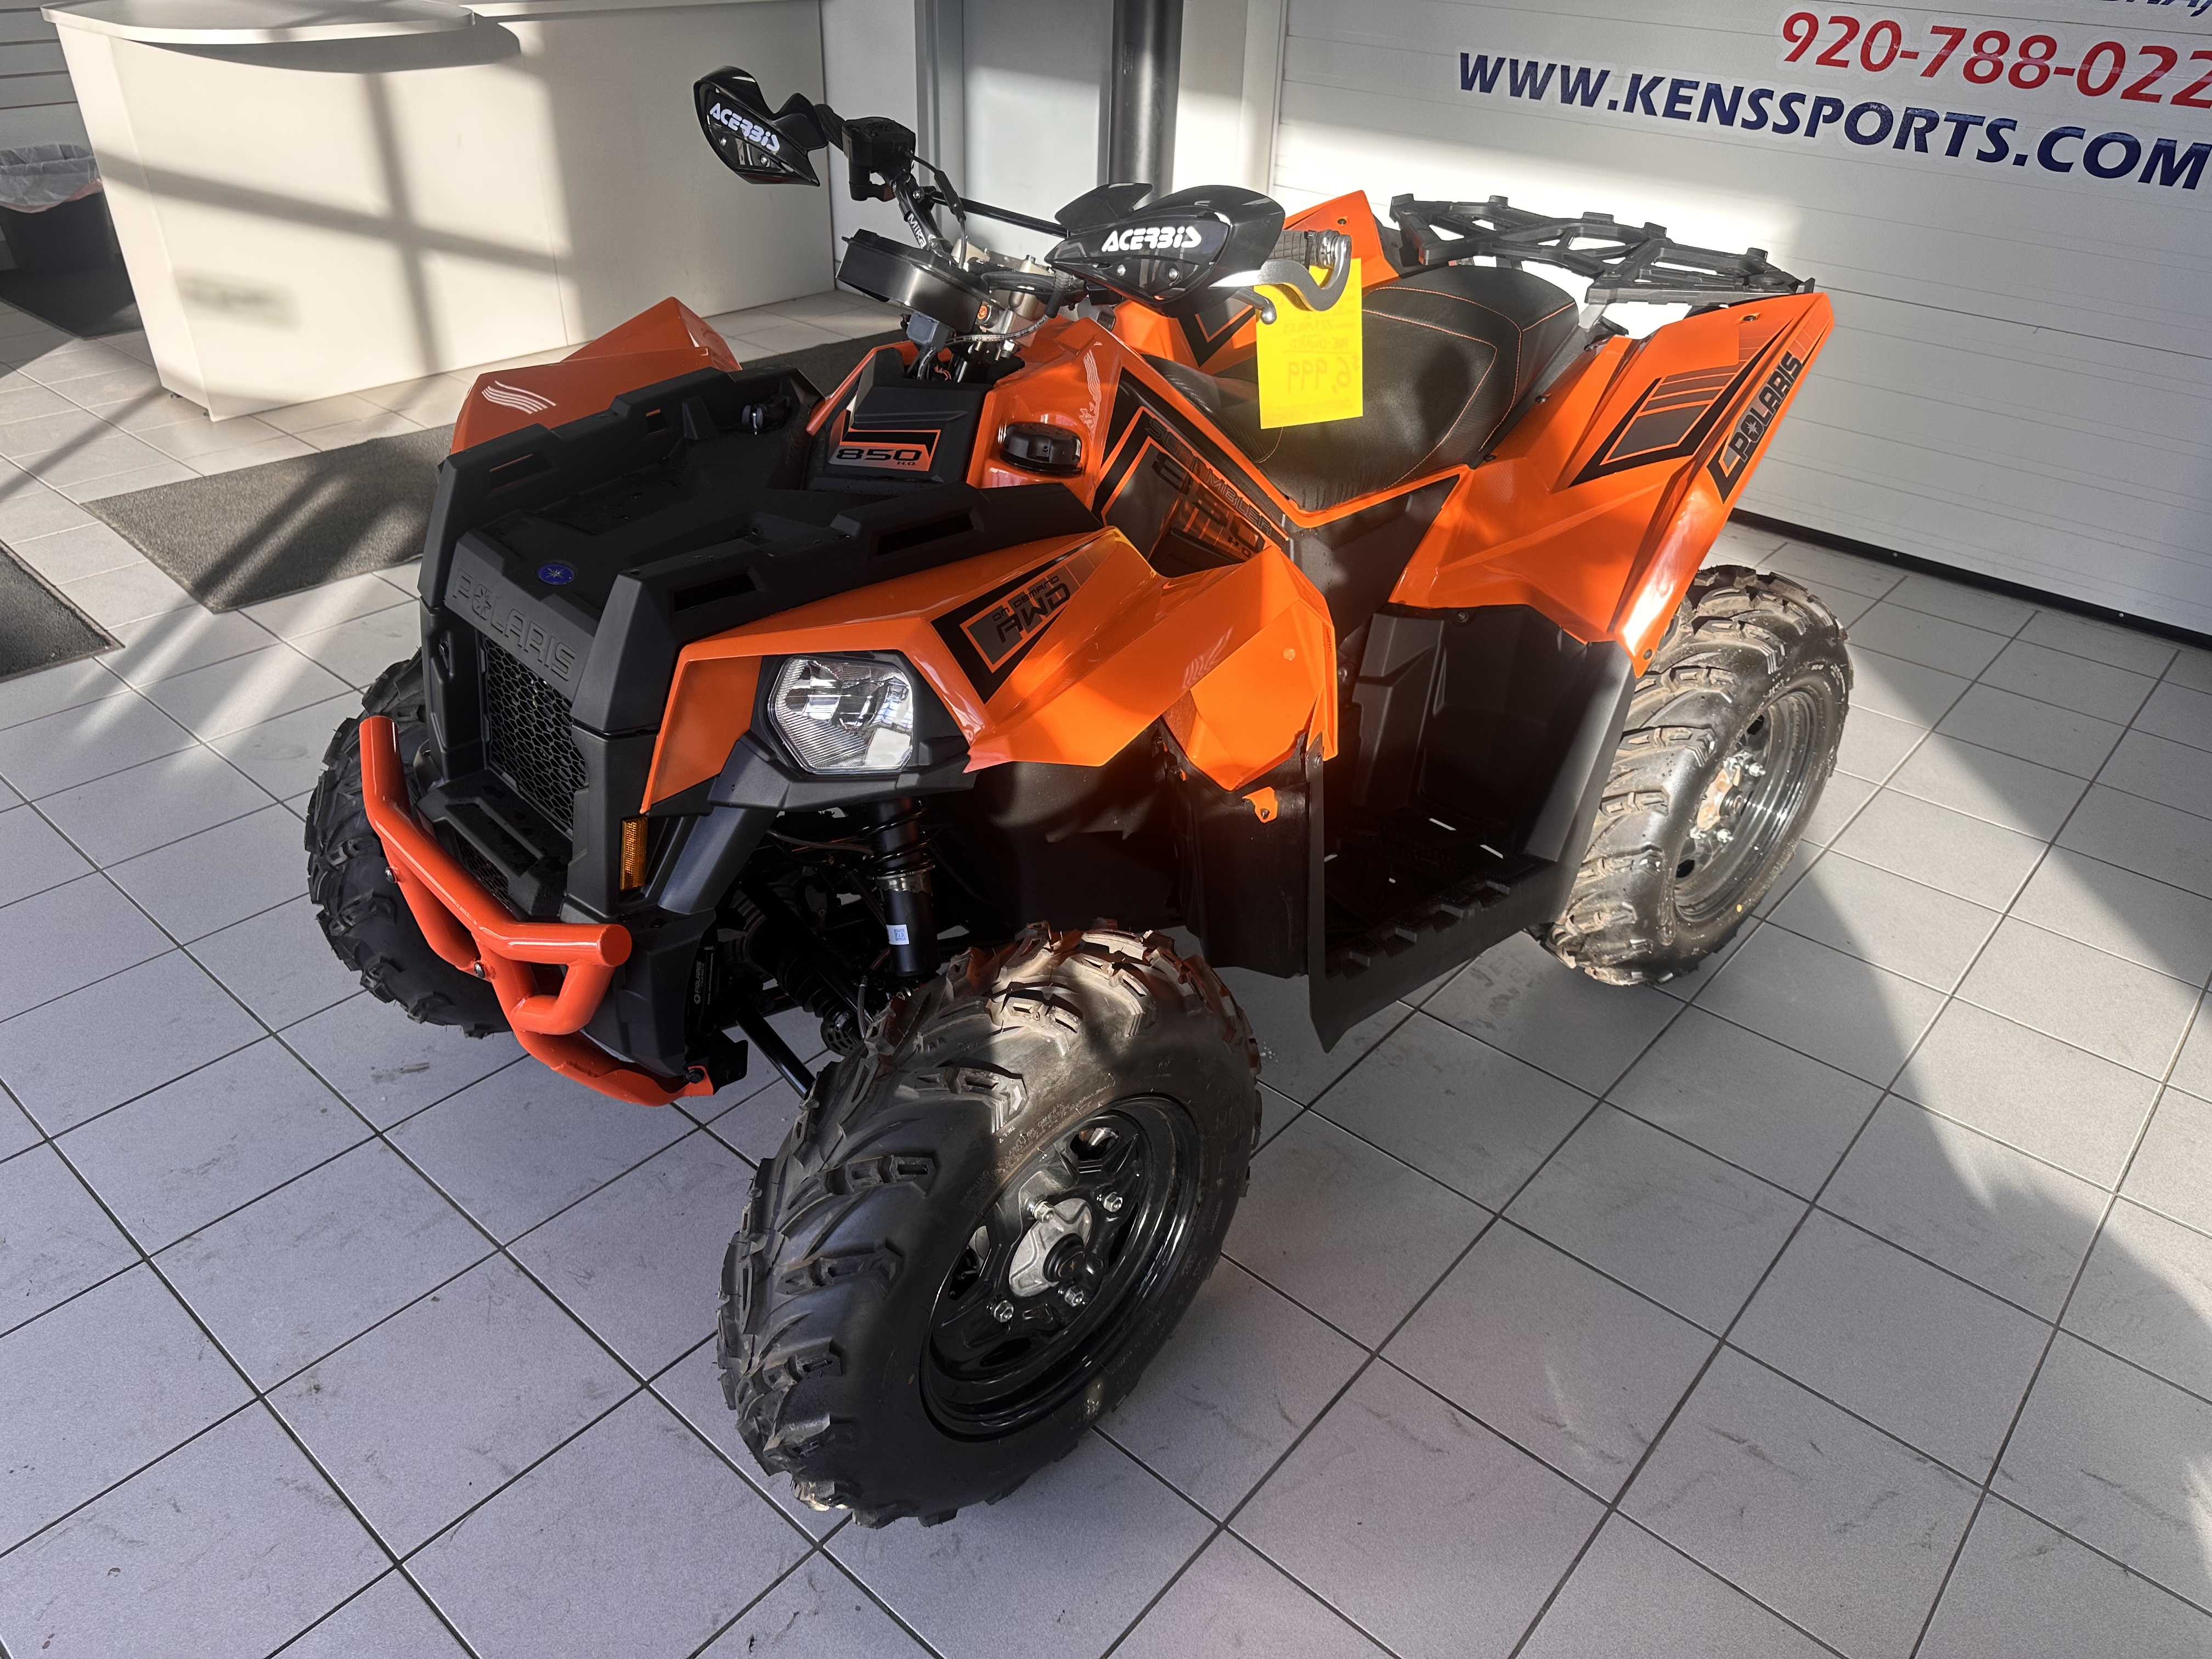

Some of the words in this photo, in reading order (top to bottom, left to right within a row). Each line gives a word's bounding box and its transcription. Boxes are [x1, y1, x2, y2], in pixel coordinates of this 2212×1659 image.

[1782, 12, 2212, 109] 920-788-022
[709, 102, 780, 152] ACERBIS
[1459, 52, 2212, 190] WWW.KENSSPORTS.COM
[1101, 225, 1202, 252] ACERBIS
[836, 448, 922, 461] 850
[1729, 351, 1803, 462] POLARIS
[1145, 417, 1272, 537] SCRAMBLER
[1152, 452, 1265, 554] 850
[453, 568, 577, 682] POLARIS
[996, 582, 1071, 644] AWD
